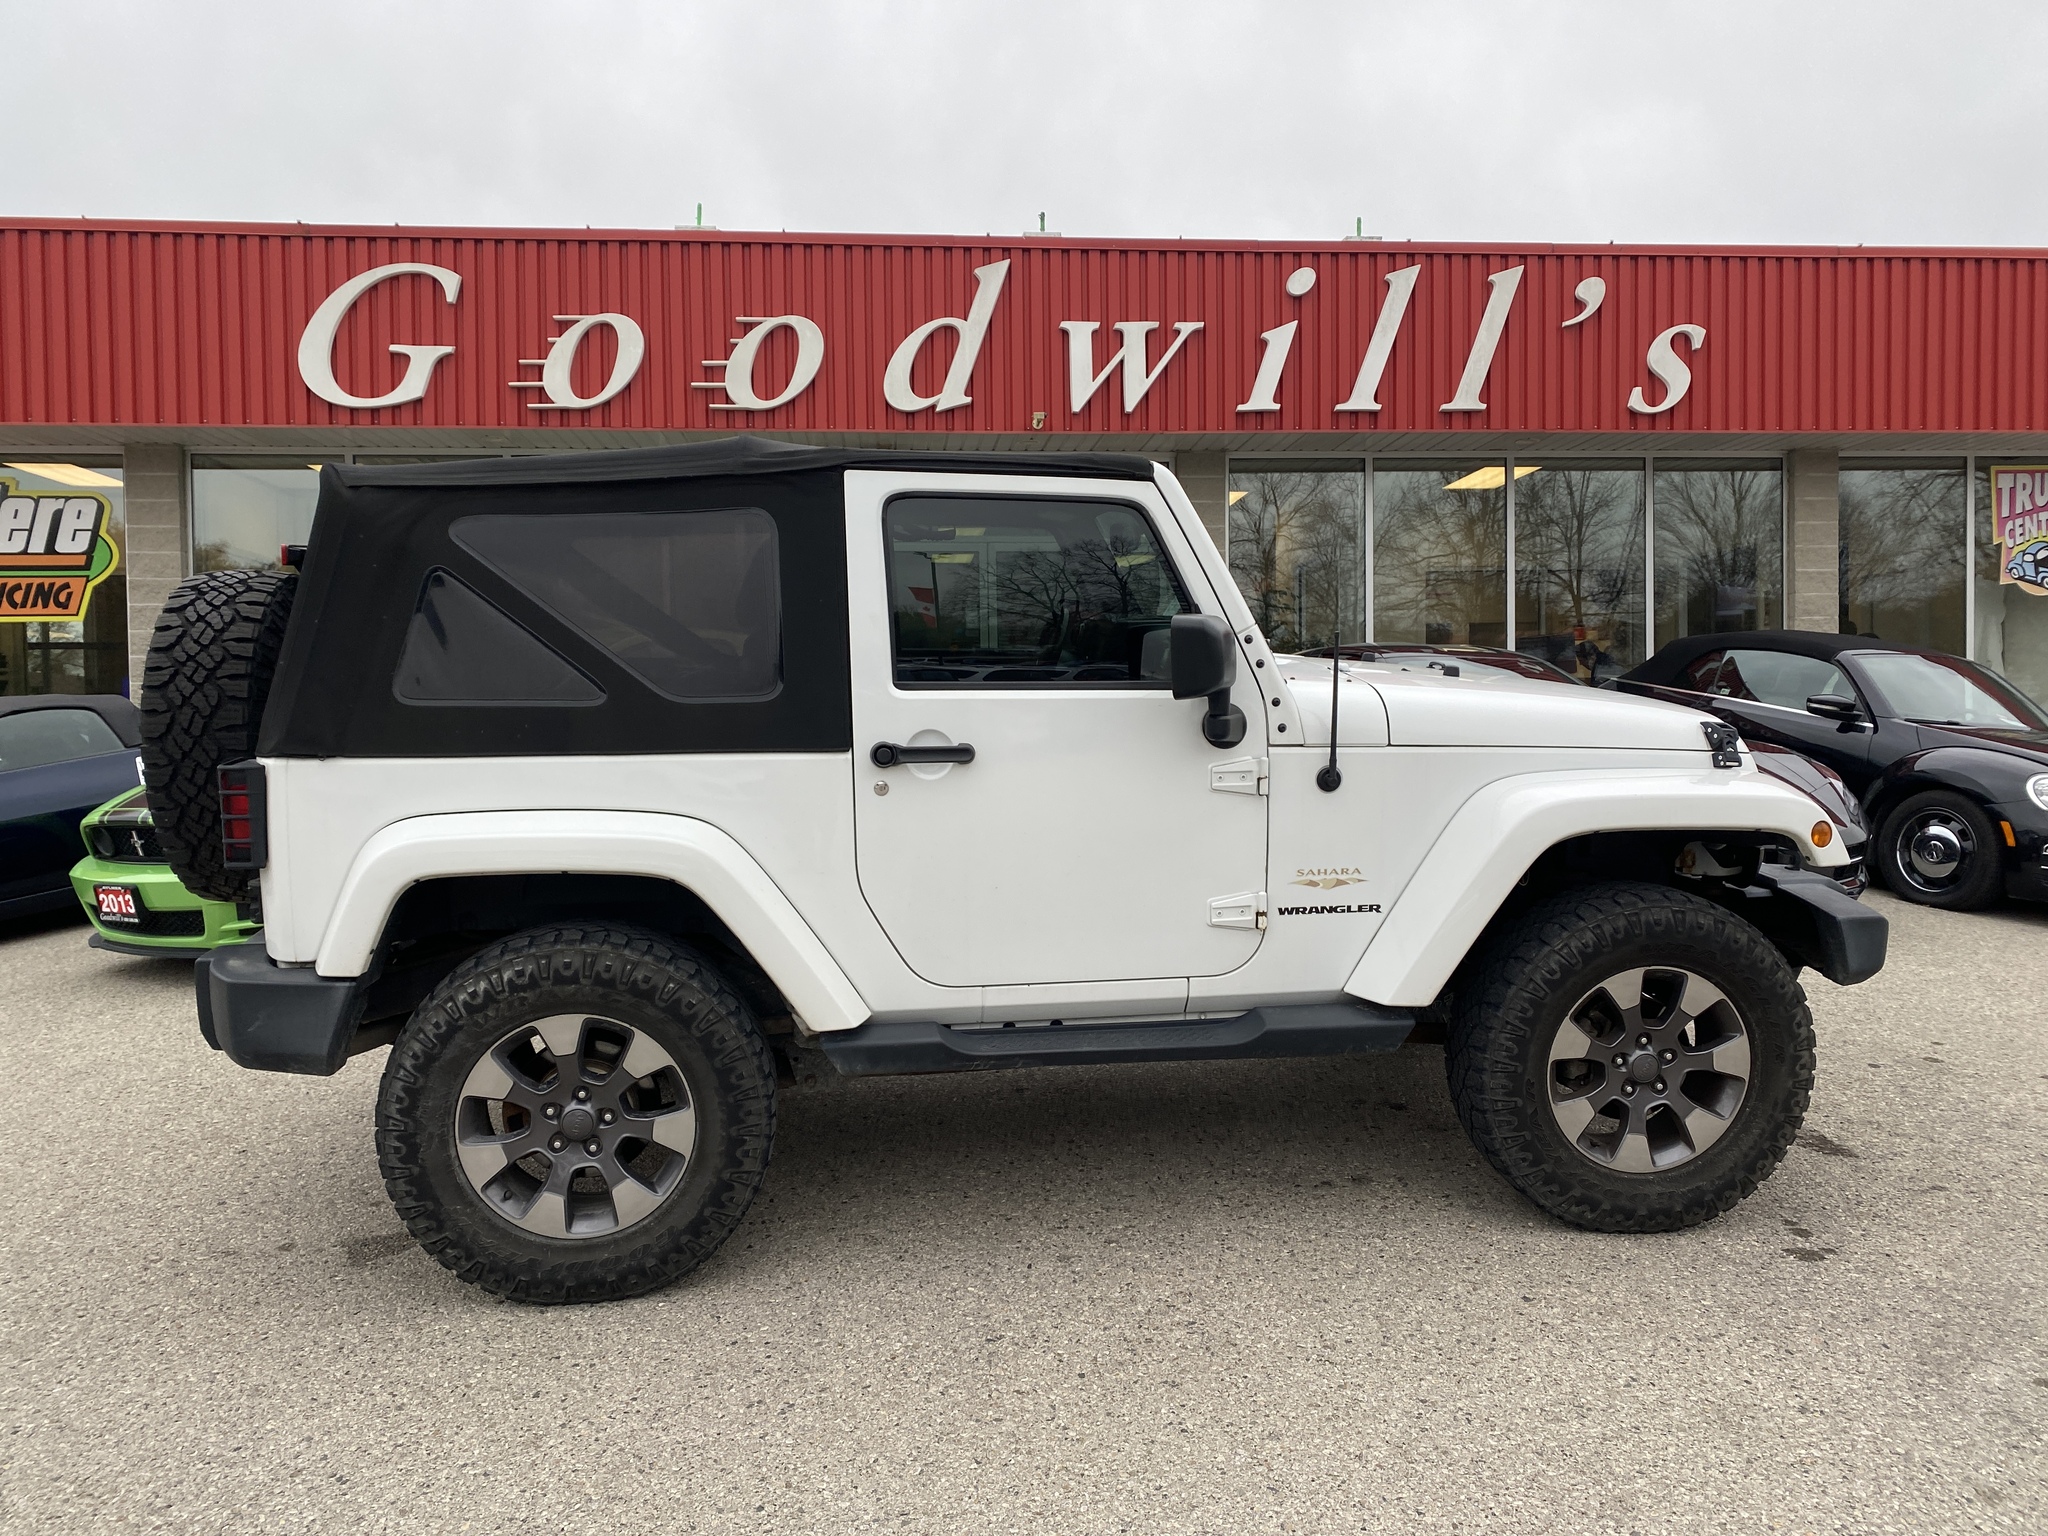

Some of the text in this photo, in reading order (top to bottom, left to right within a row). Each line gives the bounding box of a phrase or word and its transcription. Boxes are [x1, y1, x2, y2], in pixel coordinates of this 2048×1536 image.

[297, 257, 1708, 416] Goodwill's
[0, 482, 98, 554] ere
[1296, 867, 1362, 877] SAHARA
[98, 893, 136, 914] 2013
[1277, 903, 1382, 916] WRANGLER
